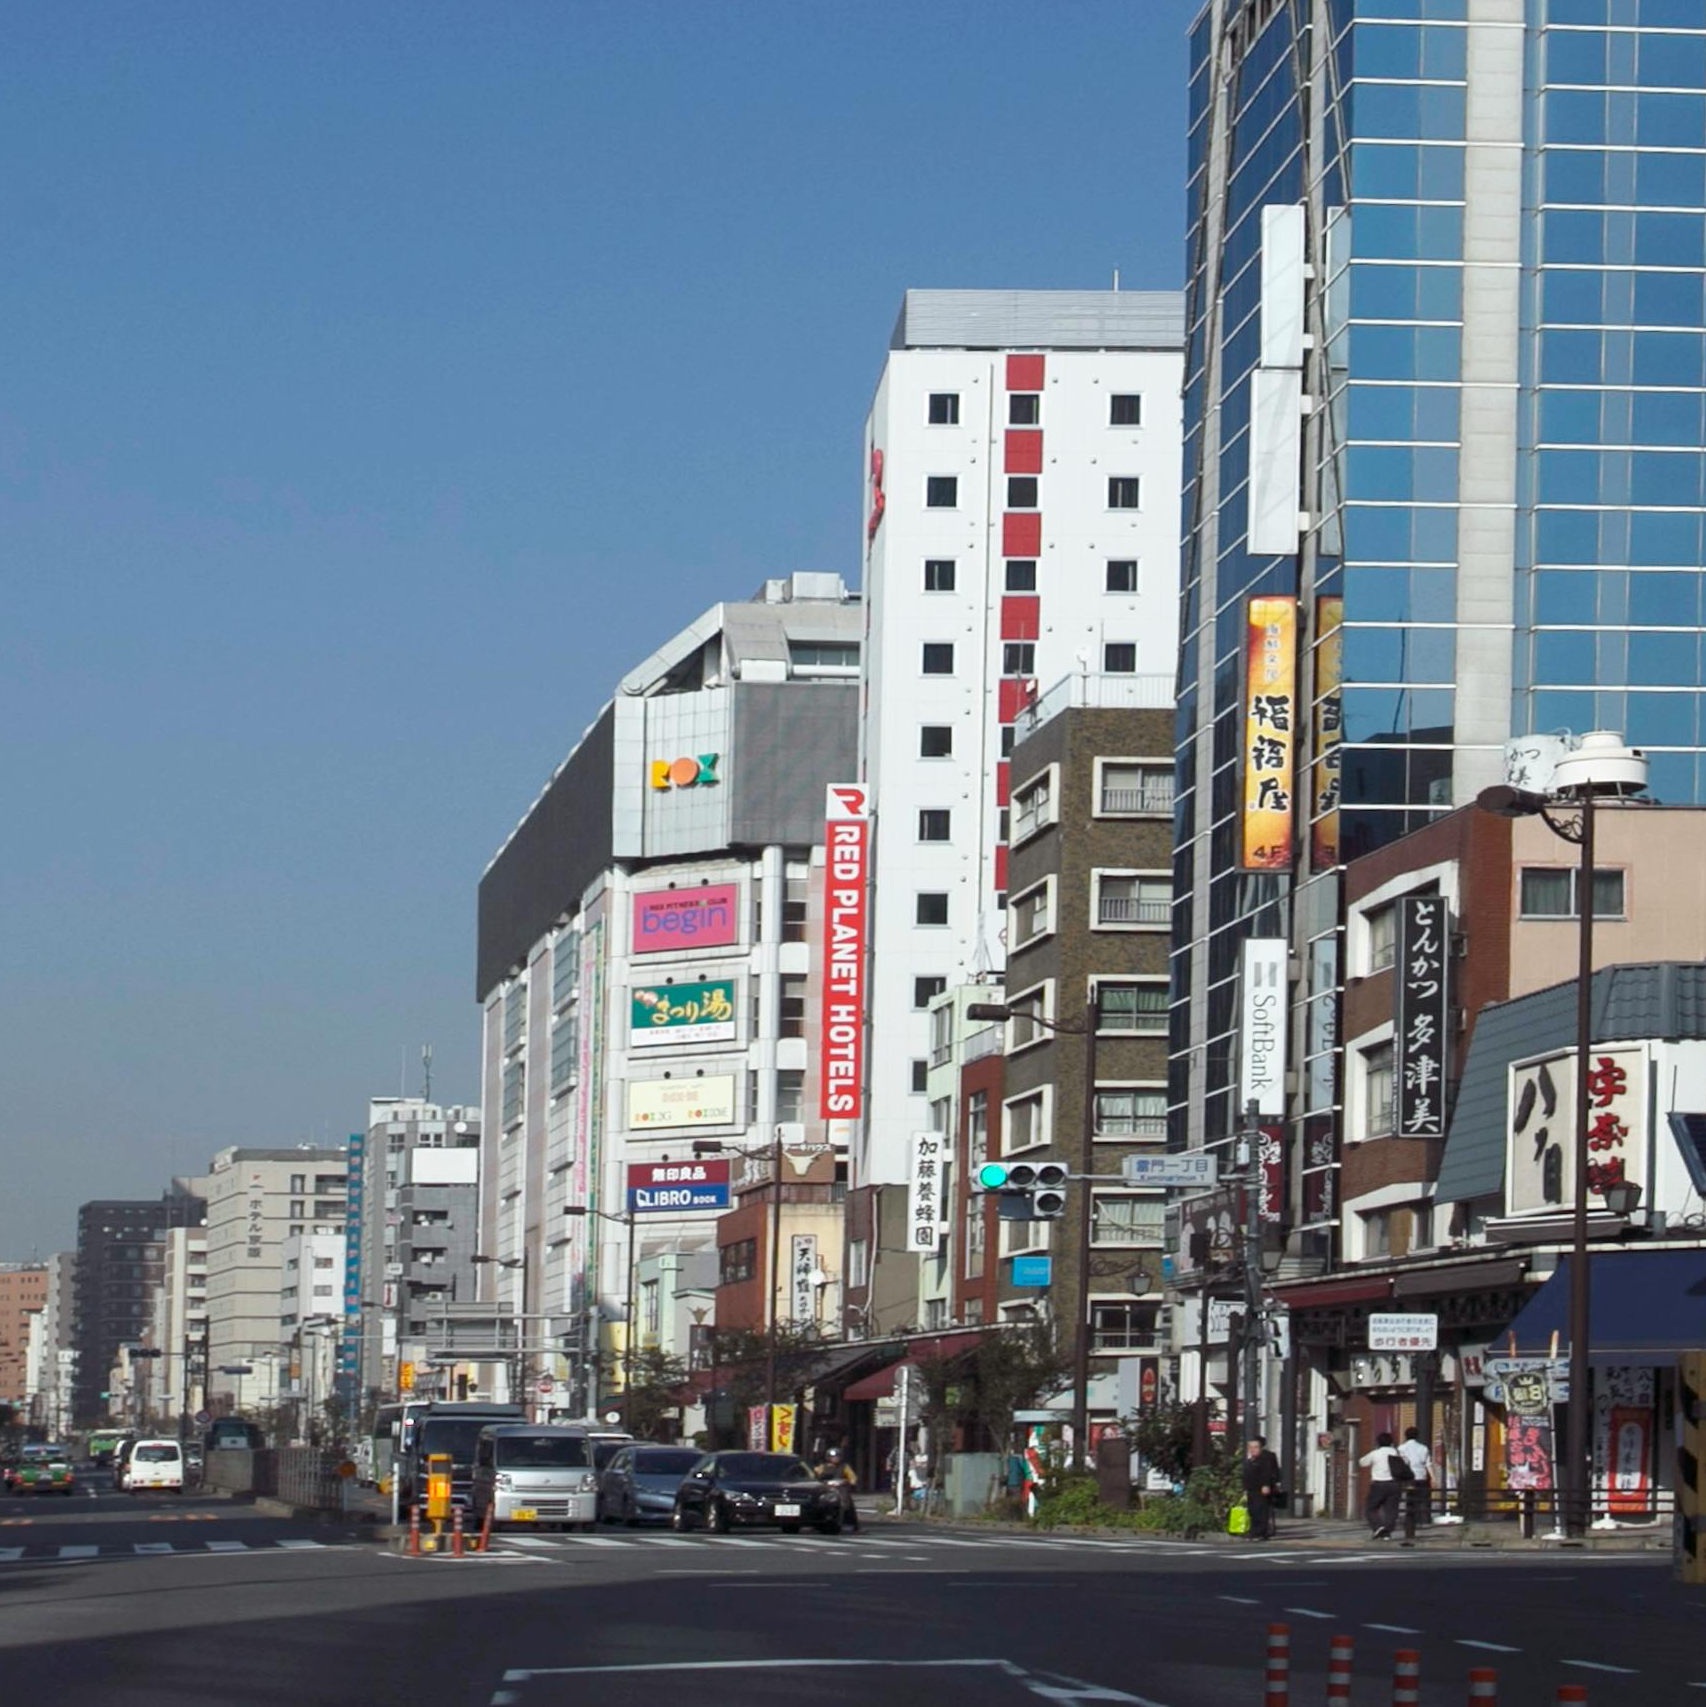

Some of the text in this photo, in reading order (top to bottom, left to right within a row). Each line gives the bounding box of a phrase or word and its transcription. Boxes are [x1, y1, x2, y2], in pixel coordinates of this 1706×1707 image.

[641, 905, 727, 934] begin
[827, 825, 860, 1113] RED PLANET HOTELS
[651, 988, 732, 1025] まつり湯
[1404, 900, 1440, 1133] とんかつ 多津美
[1250, 994, 1277, 1090] SoftBank
[652, 1166, 707, 1182] 無印良品
[1135, 1158, 1209, 1173] 雷門一丁目
[643, 1190, 692, 1206] LIBRO
[915, 1136, 939, 1247] 加藤養蜂園
